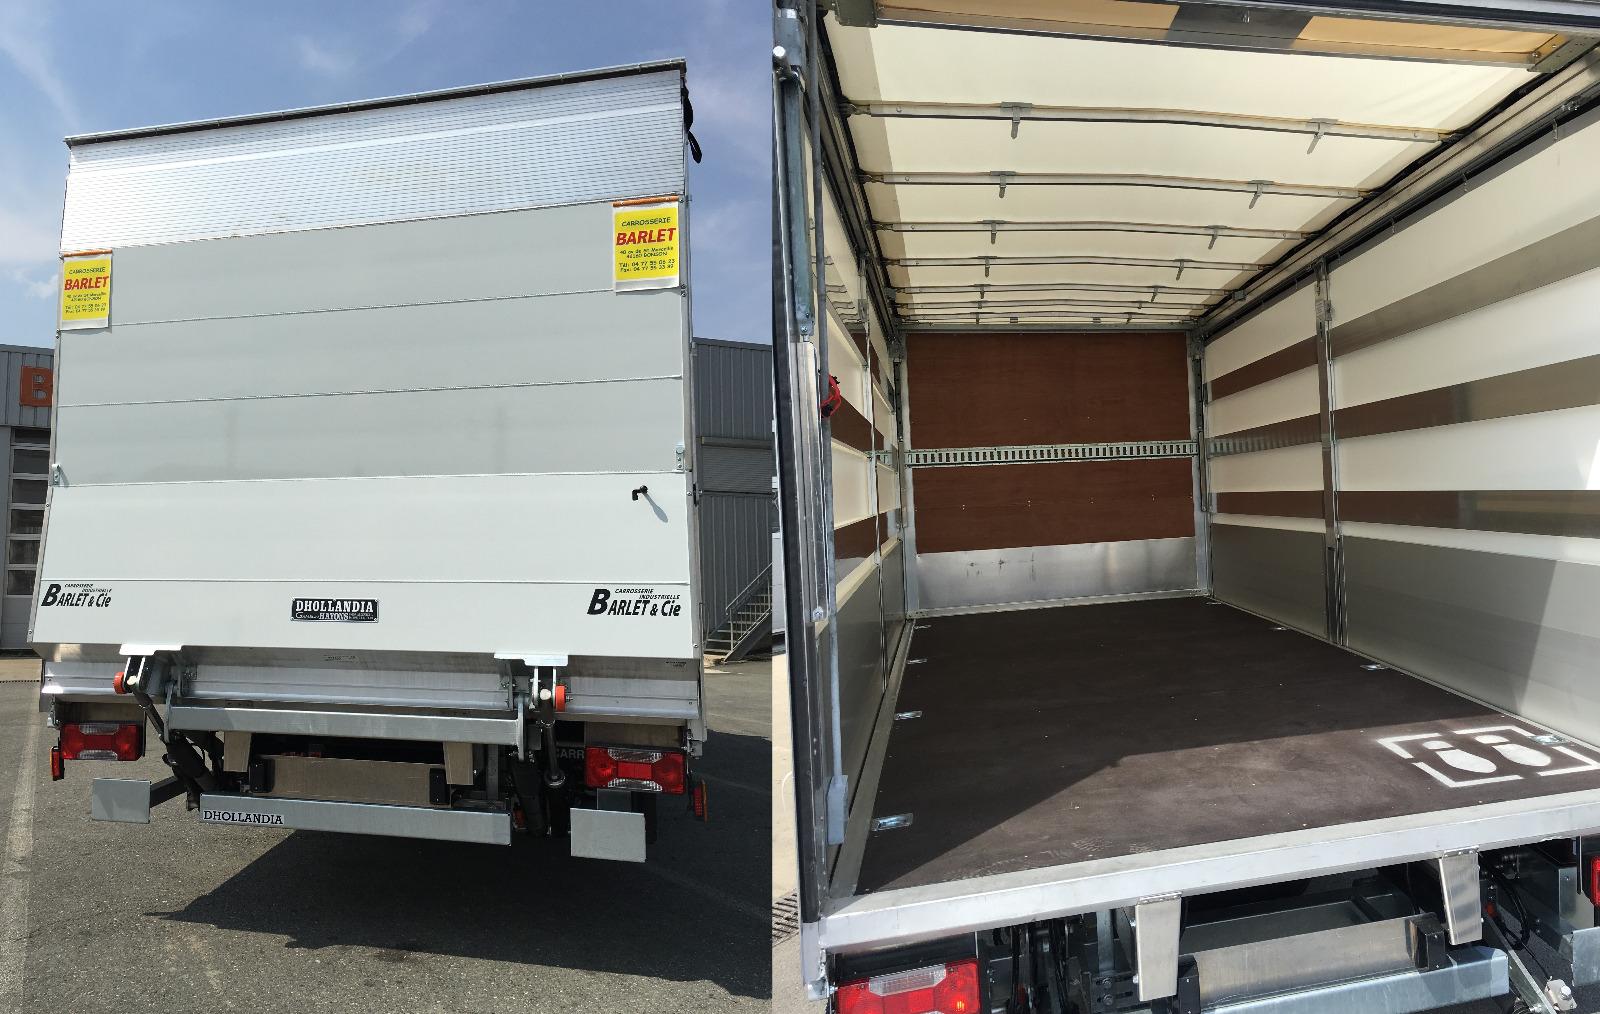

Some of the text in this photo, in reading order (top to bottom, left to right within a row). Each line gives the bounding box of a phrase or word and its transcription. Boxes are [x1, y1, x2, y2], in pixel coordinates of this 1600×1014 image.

[621, 217, 671, 227] CARROSSERIE
[616, 228, 677, 245] BARLET
[64, 276, 109, 291] BARLET
[41, 583, 112, 607] BARLET & Cie
[587, 588, 681, 616] BARLET & Cie
[295, 600, 374, 613] DHOLLANDIA
[203, 810, 283, 825] DHOLLANDIA
